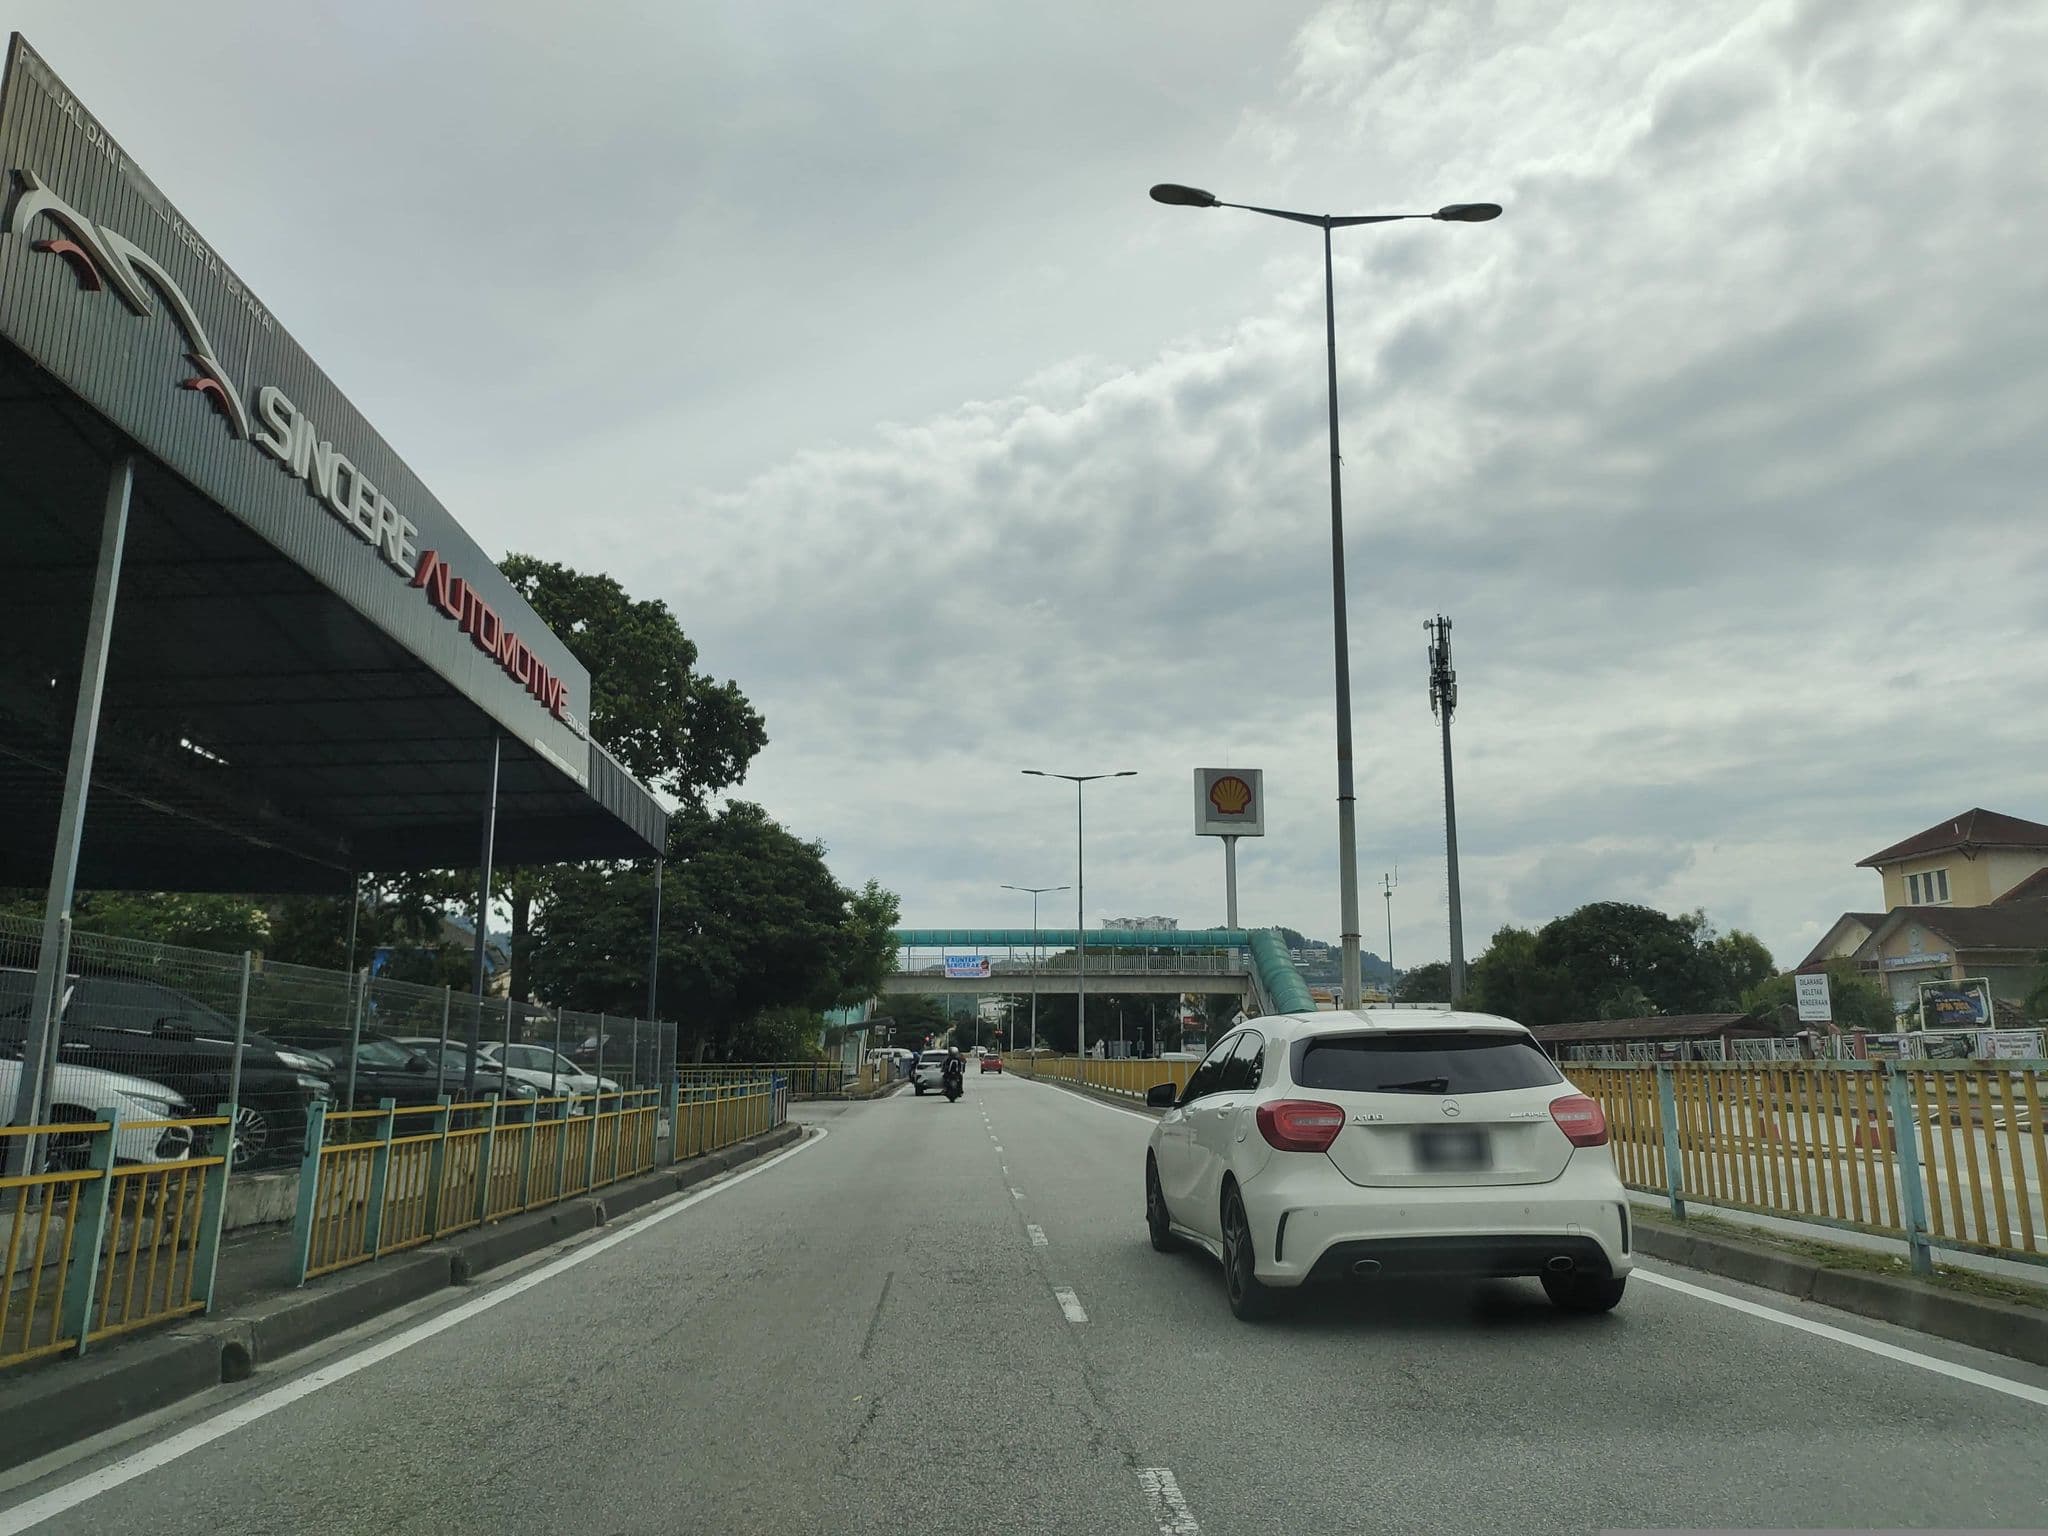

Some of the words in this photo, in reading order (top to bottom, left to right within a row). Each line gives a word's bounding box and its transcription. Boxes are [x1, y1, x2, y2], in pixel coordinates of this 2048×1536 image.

[87, 123, 116, 164] DAN
[173, 220, 218, 276] KERETA
[255, 386, 419, 578] SINCERE
[411, 550, 569, 721] AUTOMOTIVE
